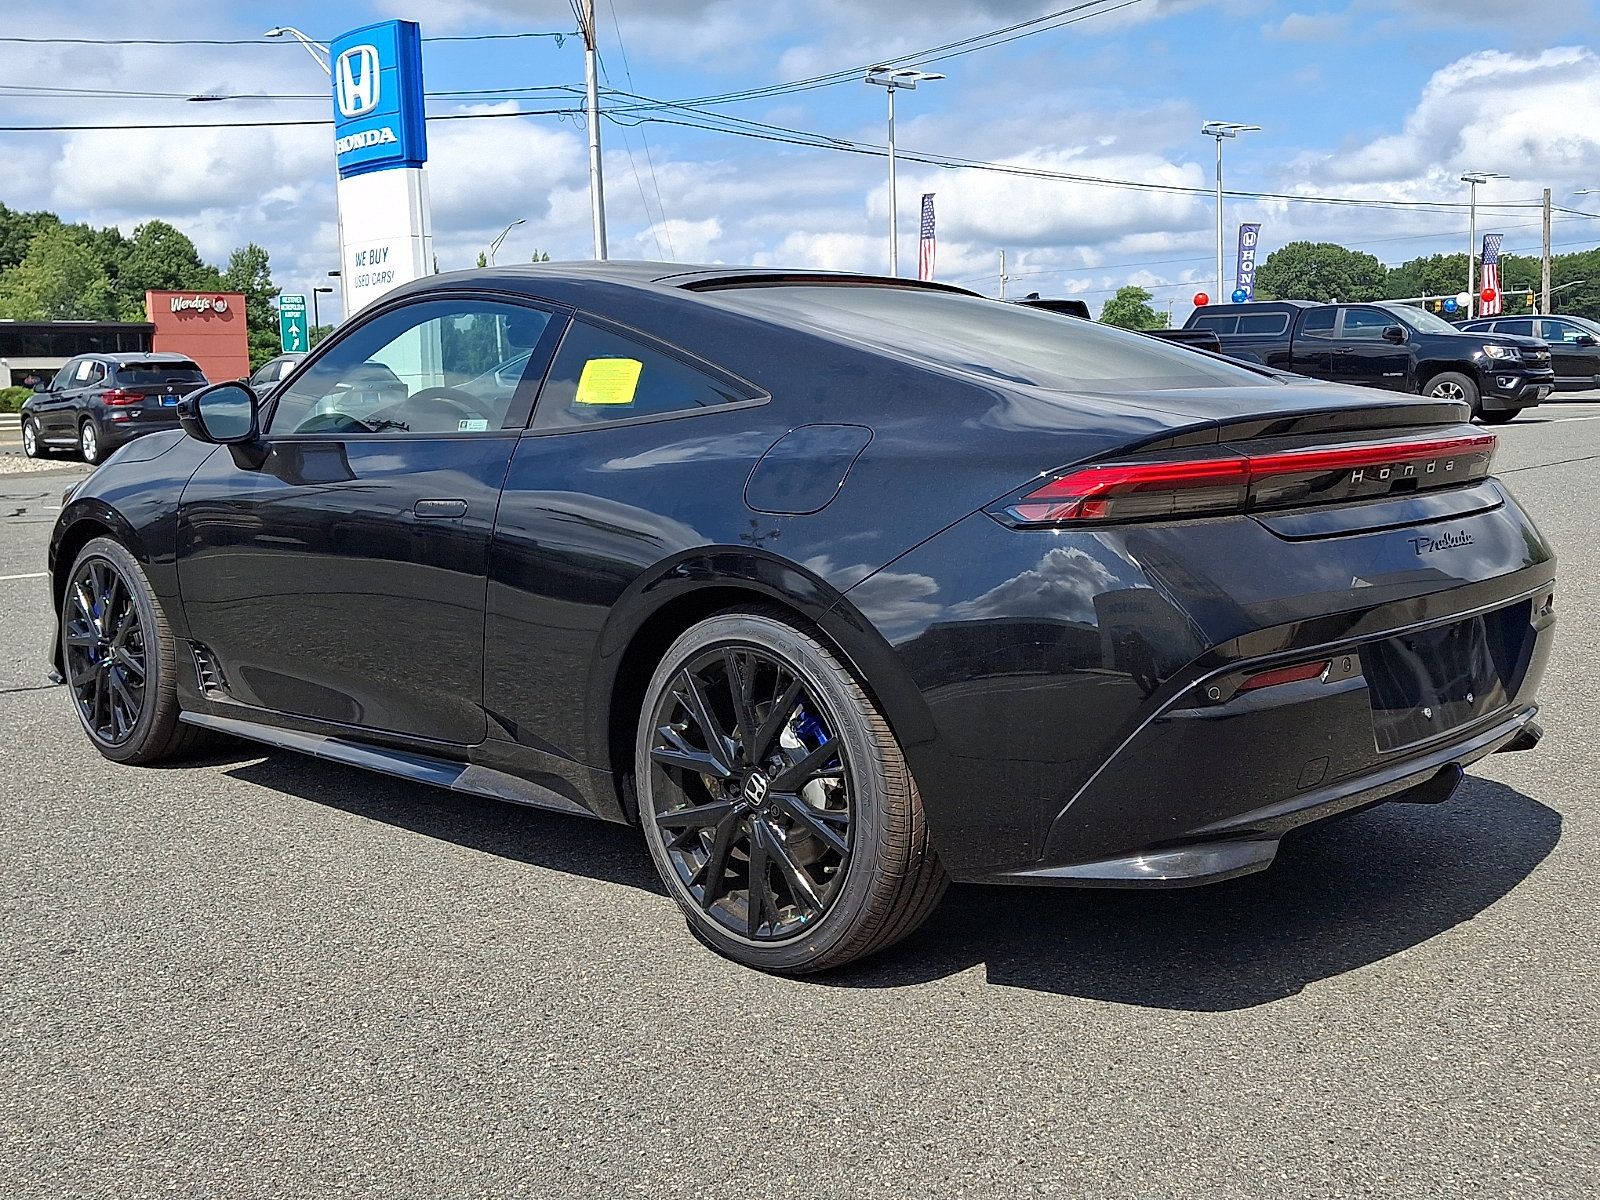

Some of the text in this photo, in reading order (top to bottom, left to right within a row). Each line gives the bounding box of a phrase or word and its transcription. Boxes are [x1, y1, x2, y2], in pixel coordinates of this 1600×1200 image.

[336, 127, 397, 155] HONDA
[355, 246, 389, 267] WE BUY
[355, 273, 370, 288] USED
[1240, 250, 1255, 302] HOND
[170, 295, 210, 313] Wendy's
[1351, 460, 1454, 483] Honda
[1408, 530, 1475, 555] Prelude
